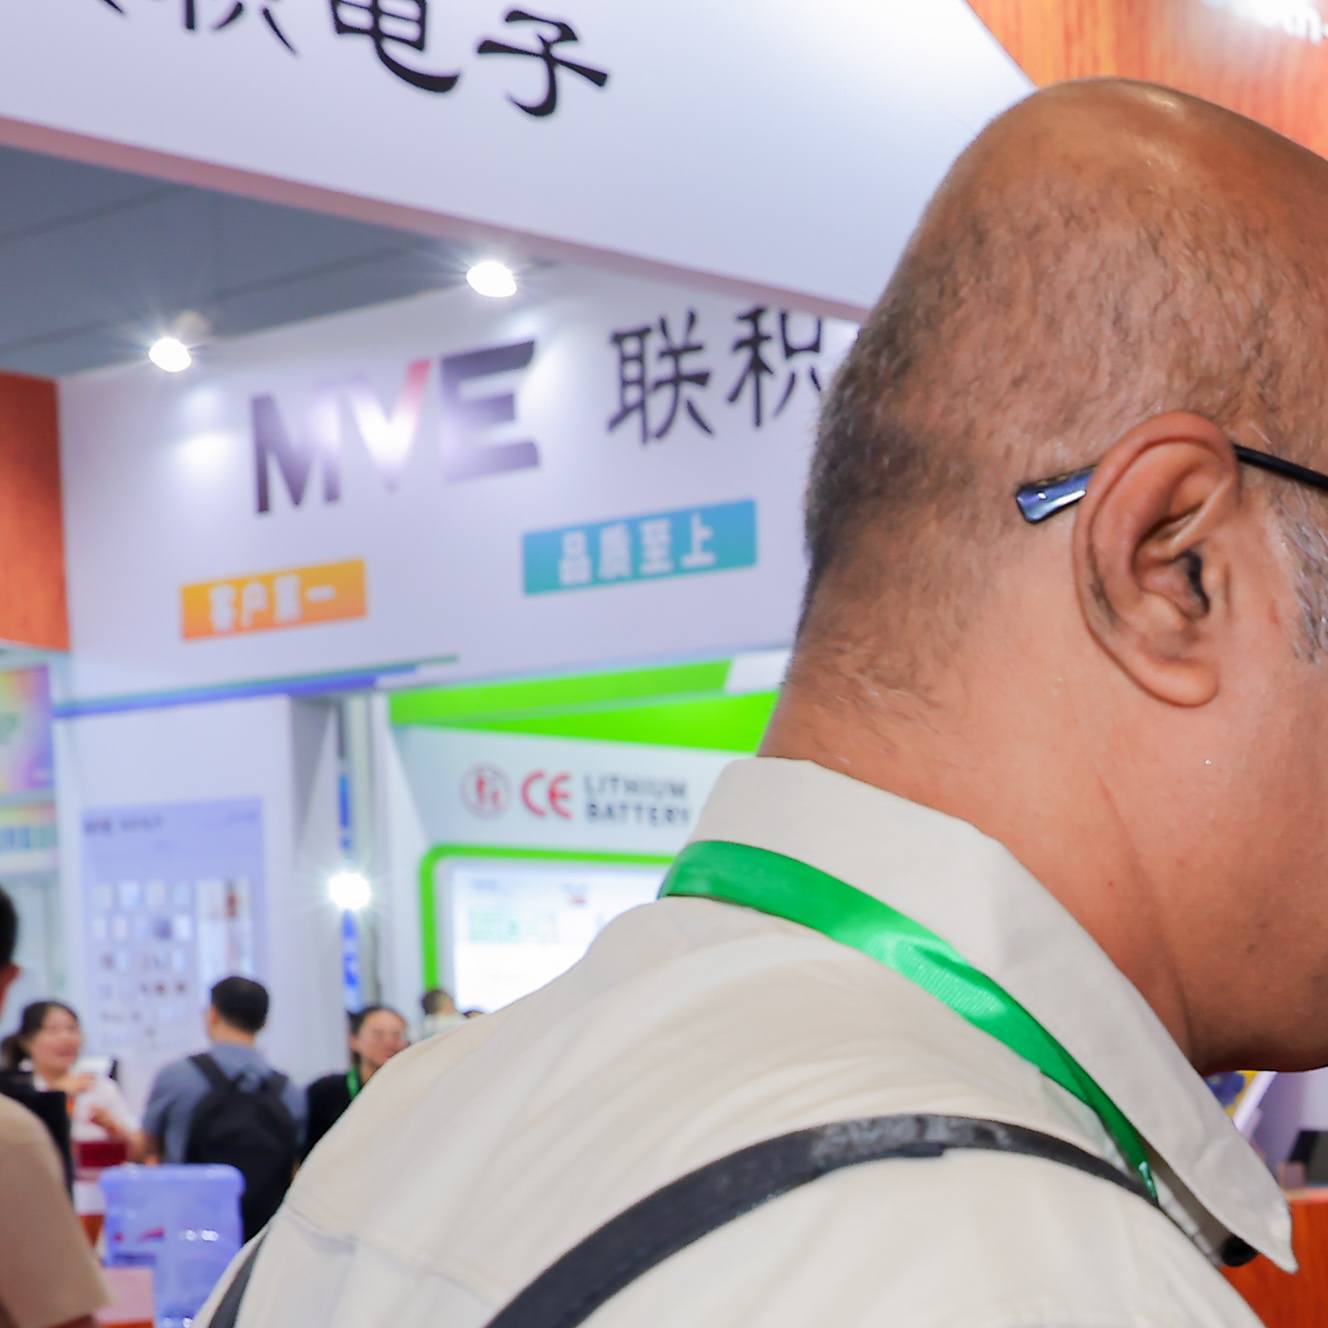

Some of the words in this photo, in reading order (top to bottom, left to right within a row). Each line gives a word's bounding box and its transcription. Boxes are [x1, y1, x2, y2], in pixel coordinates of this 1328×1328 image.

[520, 768, 573, 819] CE
[583, 771, 688, 798] LITHIUM
[586, 801, 690, 827] BATTERY
